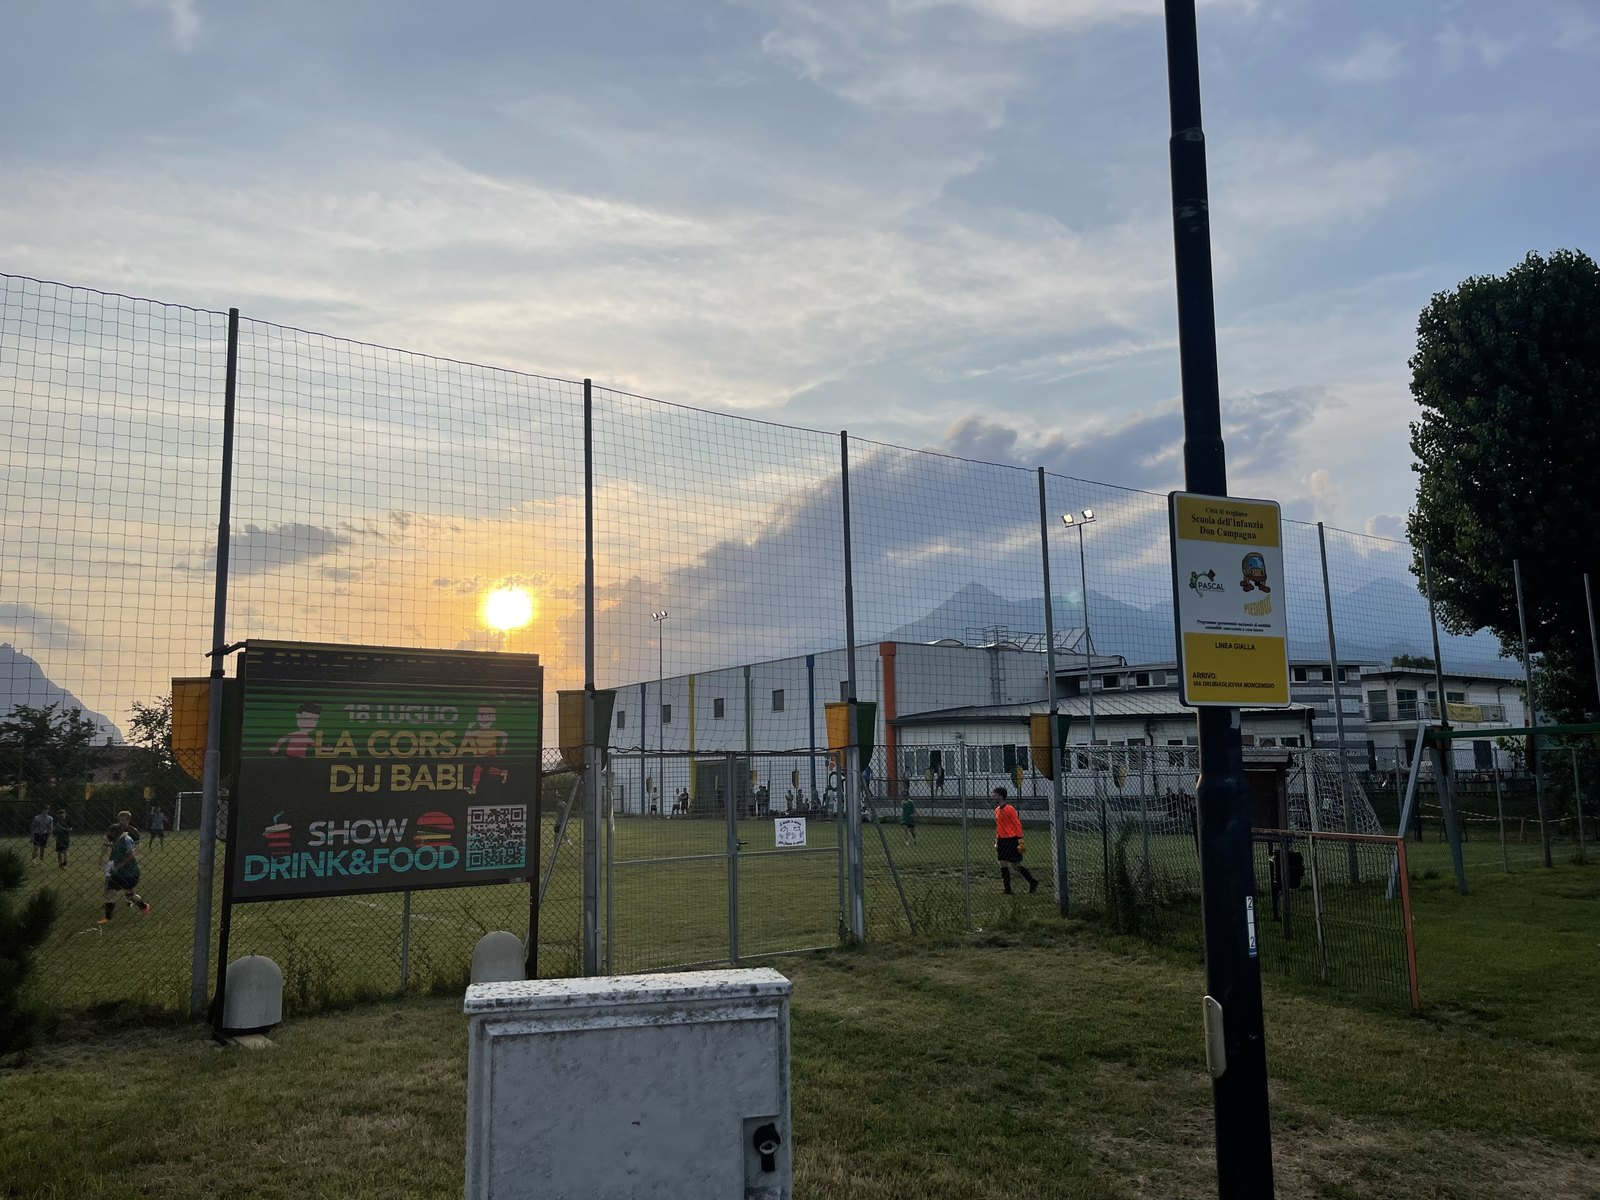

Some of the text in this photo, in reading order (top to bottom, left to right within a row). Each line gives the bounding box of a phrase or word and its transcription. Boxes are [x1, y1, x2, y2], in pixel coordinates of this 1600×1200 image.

[1192, 514, 1264, 528] Scuola dell'Infanzia
[1200, 526, 1256, 540] Don Campagna
[1198, 582, 1224, 590] PASCAL
[344, 703, 459, 724] 18 LUGLIO
[314, 730, 482, 758] LA CORSA
[329, 763, 465, 793] DIJ BABI
[308, 818, 408, 847] SHOW
[244, 845, 460, 882] DRINK&FOOD
[1248, 897, 1252, 908] 2
[1250, 936, 1255, 948] 2
